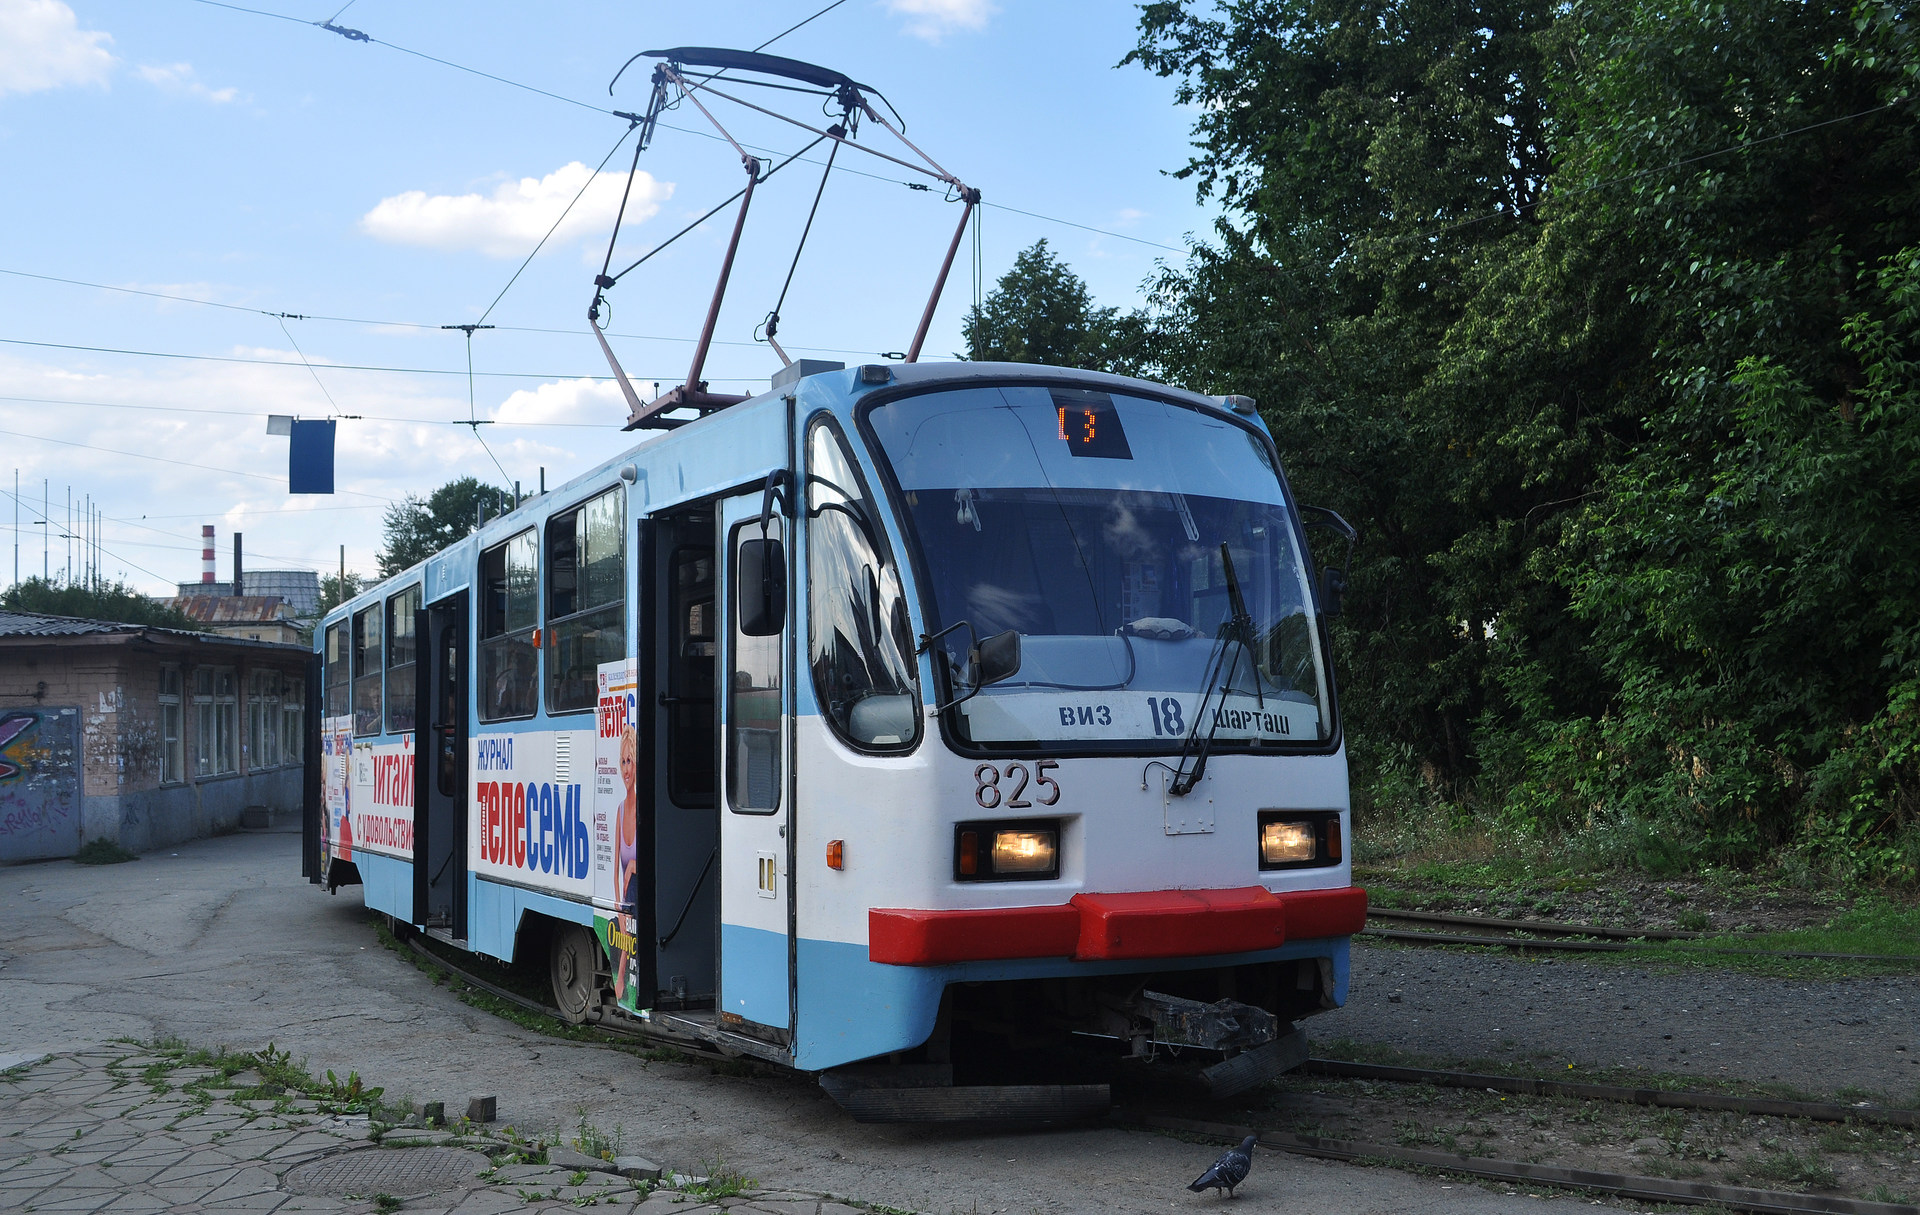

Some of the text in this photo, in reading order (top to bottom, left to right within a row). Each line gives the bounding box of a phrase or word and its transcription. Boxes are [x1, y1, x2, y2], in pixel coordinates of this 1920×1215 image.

[1059, 705, 1112, 726] ВИЗ
[1148, 697, 1185, 736] 18
[477, 738, 513, 771] ЖУРНАЛ
[974, 760, 1060, 808] 825
